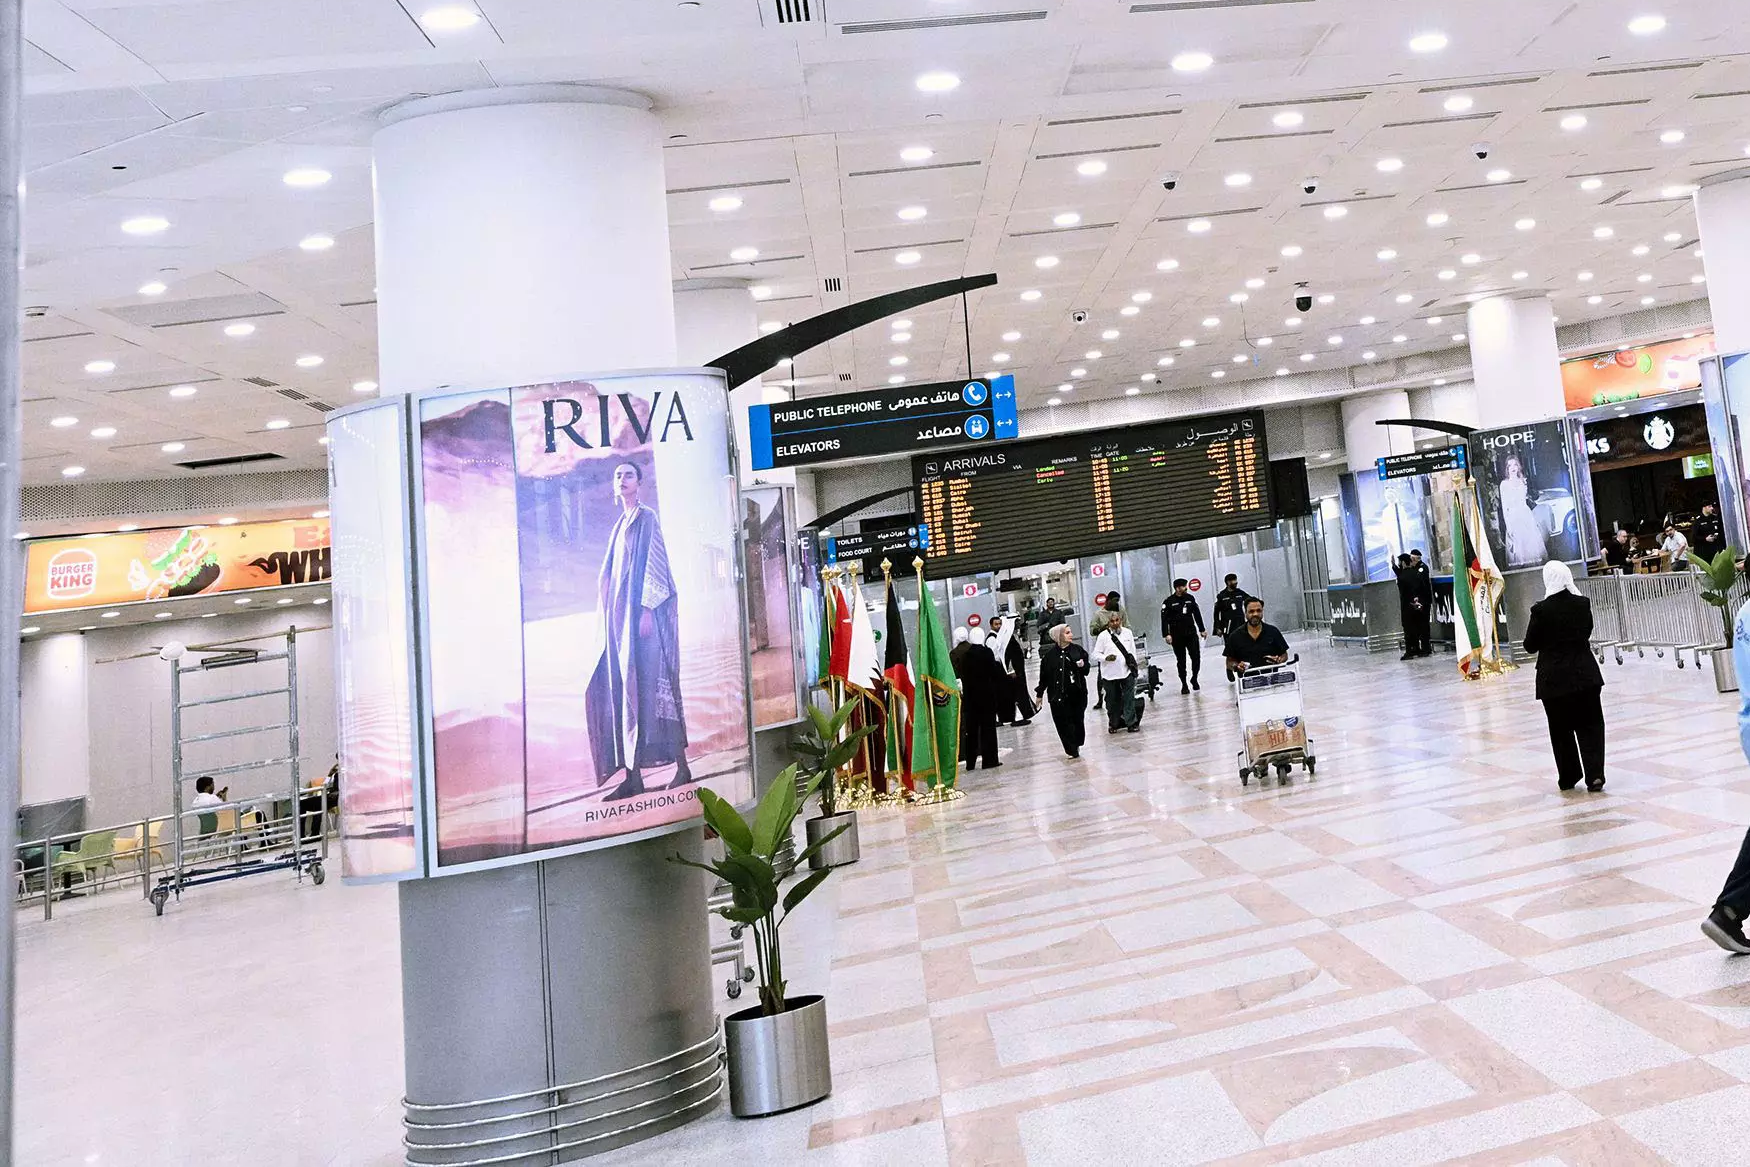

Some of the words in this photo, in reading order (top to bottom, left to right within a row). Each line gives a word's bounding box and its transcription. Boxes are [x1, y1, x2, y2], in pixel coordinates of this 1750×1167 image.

[930, 391, 960, 405] هاتف
[774, 408, 814, 424] PUBLIC
[816, 400, 882, 418] TELEPHONE
[542, 390, 694, 453] RIVA
[916, 425, 962, 441] مصاعد
[1482, 430, 1536, 450] HOPE
[776, 439, 841, 457] ELEVATORS
[921, 475, 941, 483] FLIGHT
[1051, 456, 1078, 465] REMARKS
[943, 453, 1006, 472] ARRIVALS
[1387, 467, 1417, 476] ELEVATORS
[836, 536, 863, 546] TOILETS
[838, 550, 853, 558] FOOD
[853, 547, 873, 556] COURT
[51, 562, 94, 576] BURGER
[50, 573, 93, 588] KING
